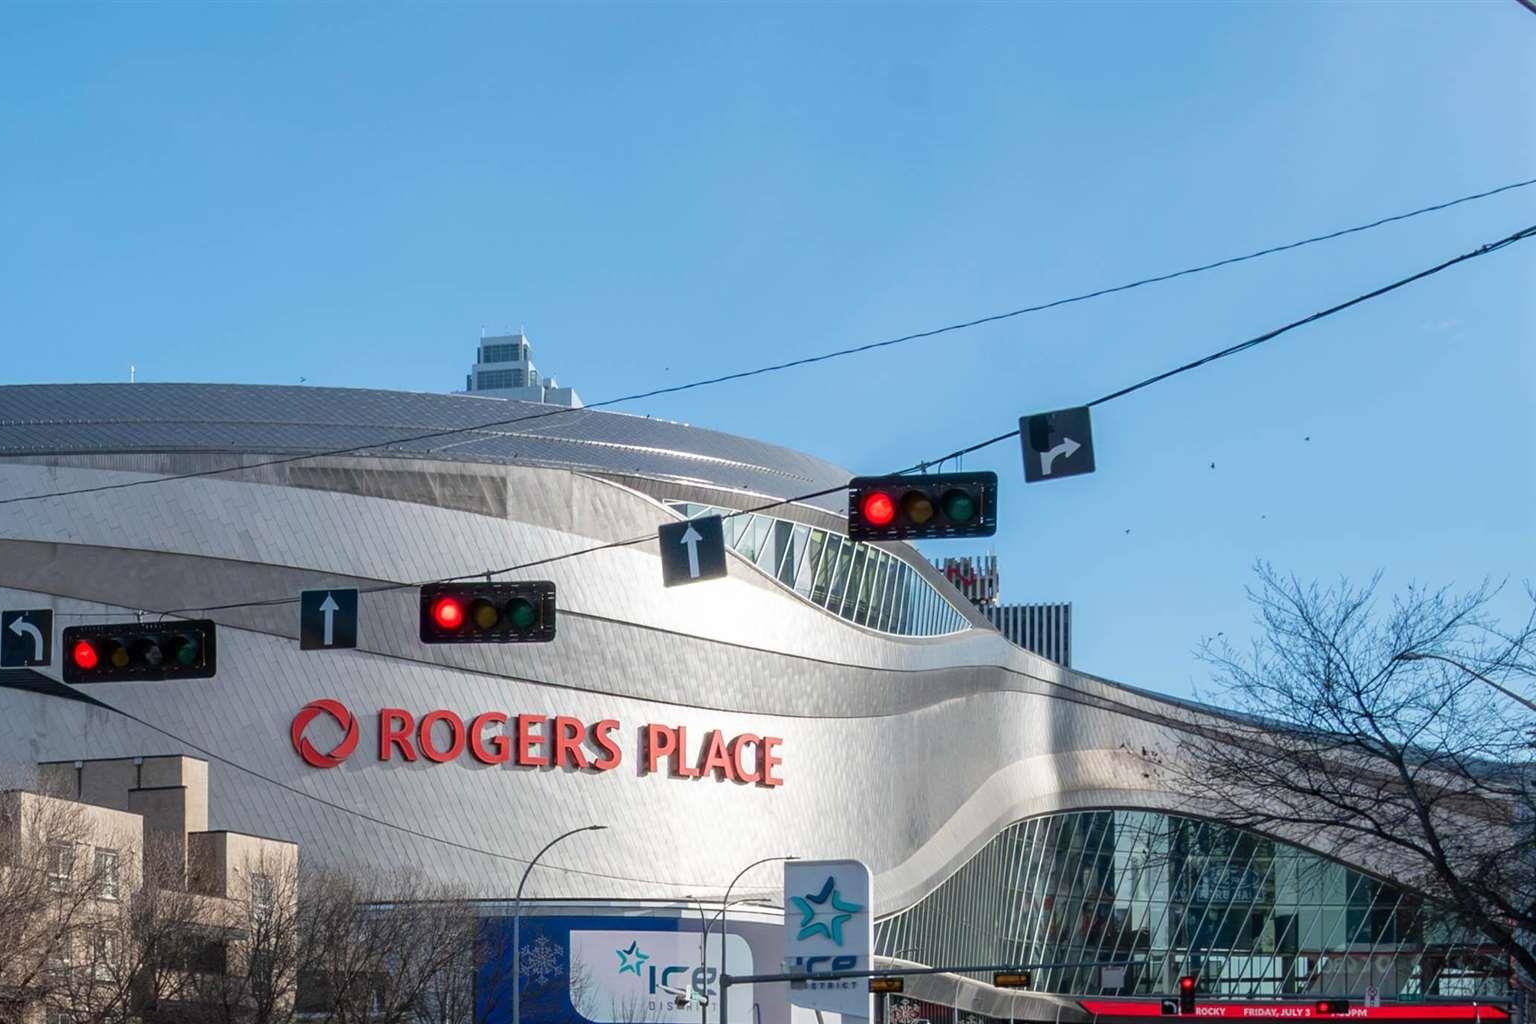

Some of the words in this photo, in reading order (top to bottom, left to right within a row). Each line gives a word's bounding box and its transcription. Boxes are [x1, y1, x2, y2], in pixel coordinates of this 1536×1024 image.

[379, 707, 622, 770] ROGERS
[647, 723, 784, 786] PLACE
[1195, 1007, 1226, 1016] ROCKY
[1280, 1008, 1303, 1017] JULY
[1305, 1008, 1311, 1017] 3
